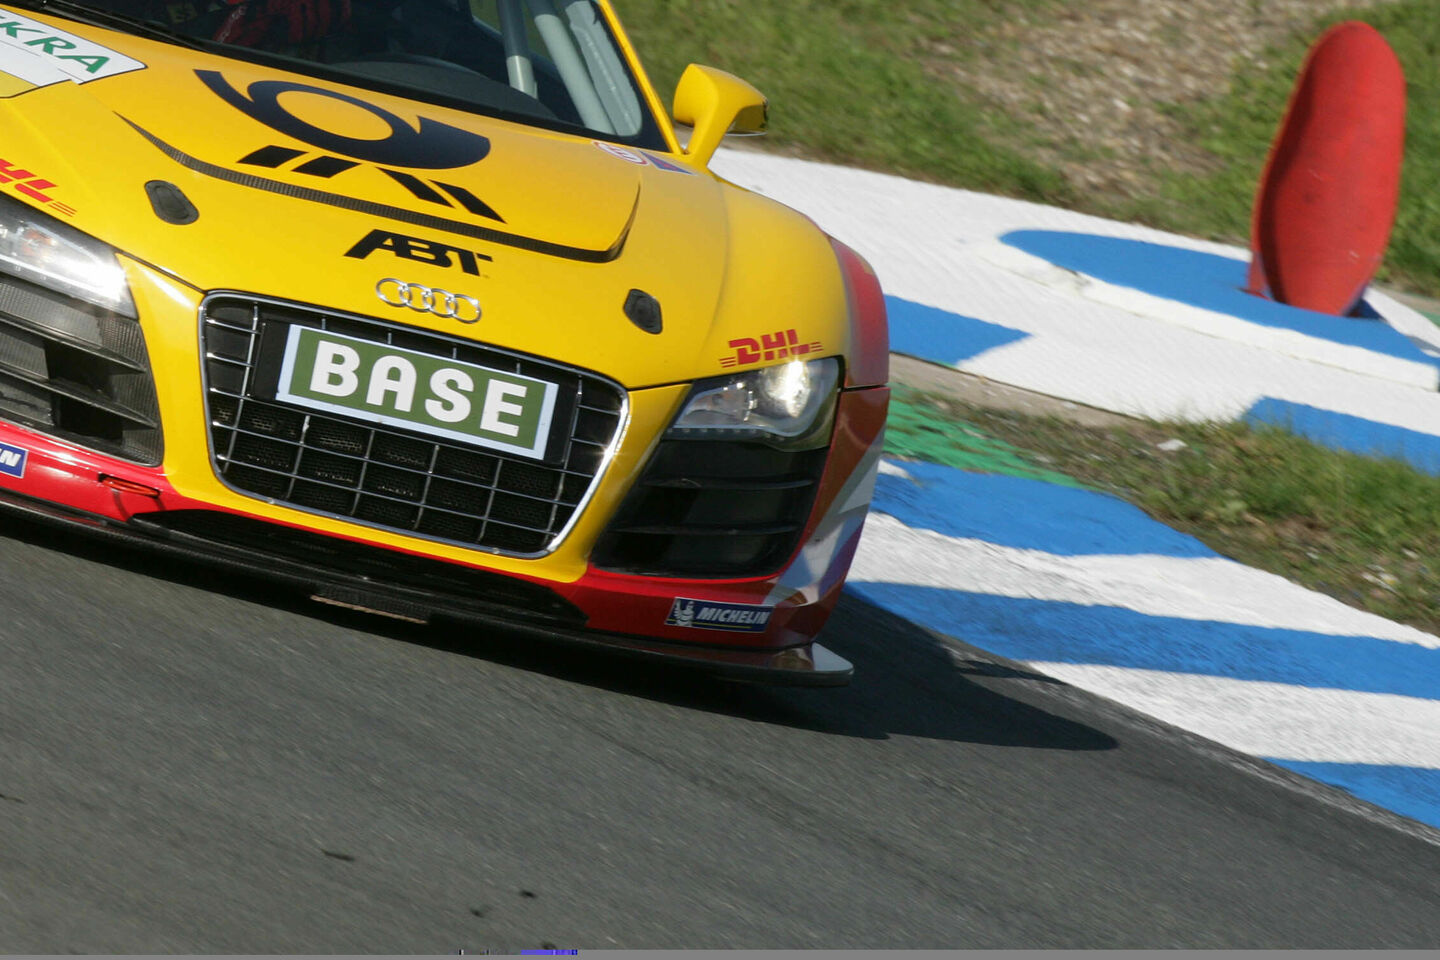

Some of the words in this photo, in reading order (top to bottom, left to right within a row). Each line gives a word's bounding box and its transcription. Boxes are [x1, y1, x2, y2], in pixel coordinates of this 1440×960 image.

[343, 228, 494, 277] ABT
[728, 328, 811, 365] DHL
[307, 338, 530, 439] BASE
[696, 606, 771, 626] MICHELIN
